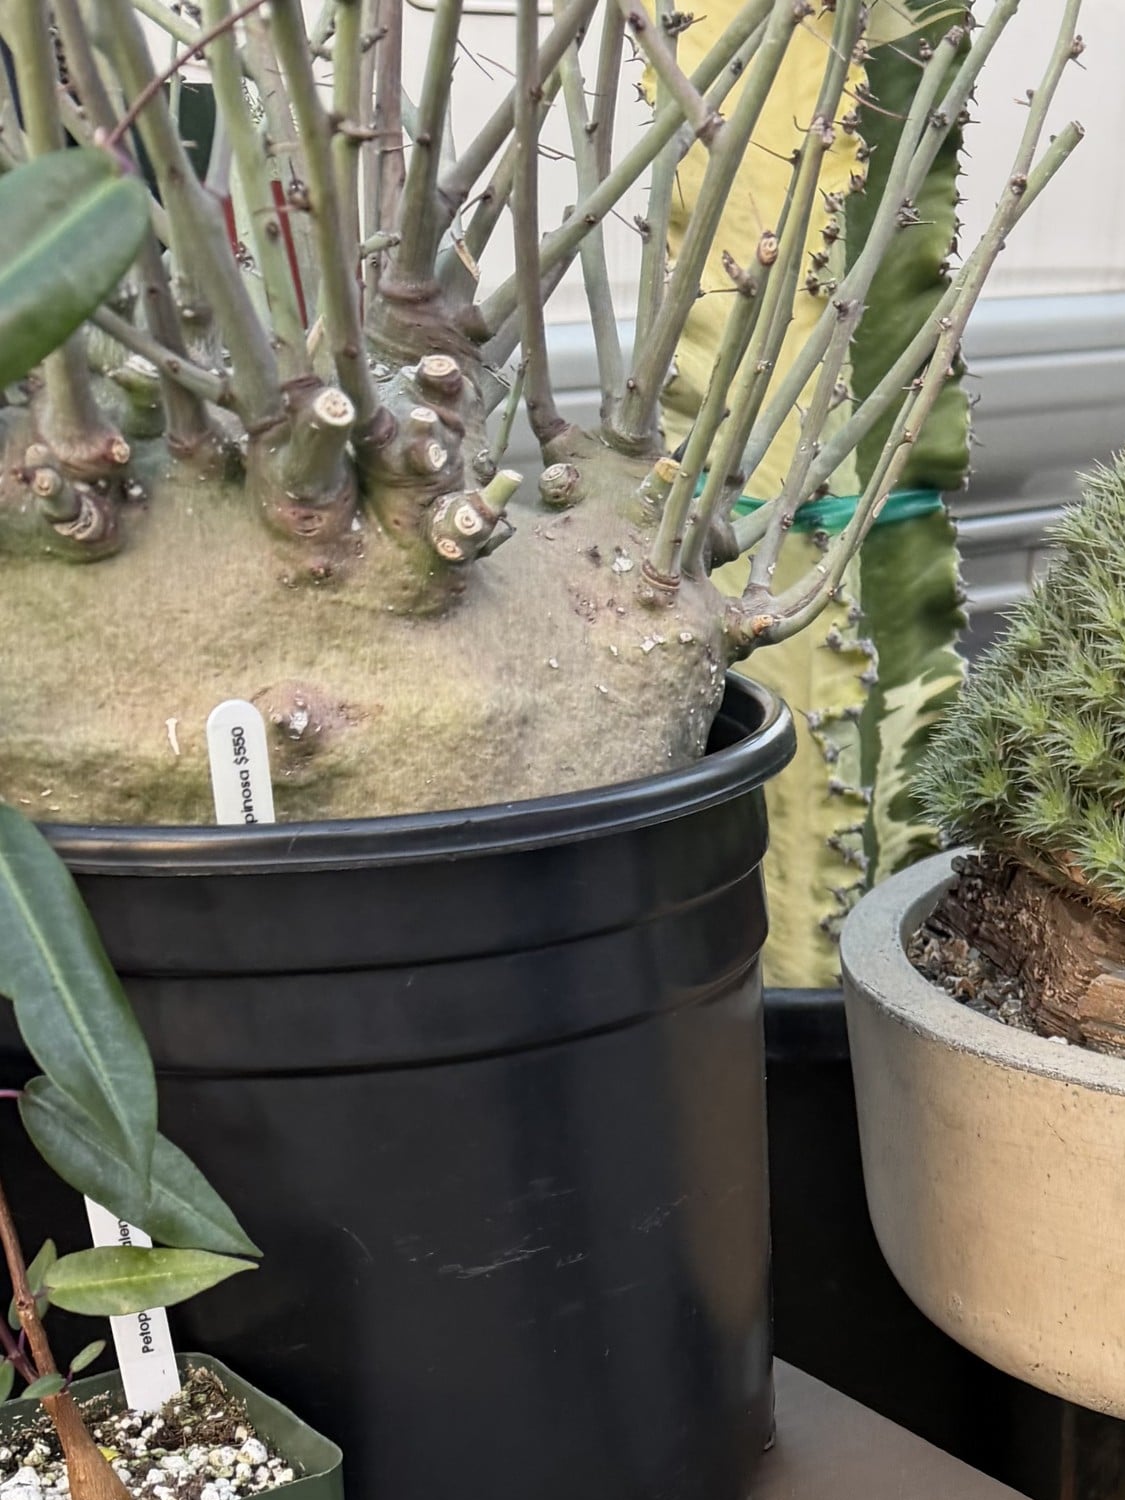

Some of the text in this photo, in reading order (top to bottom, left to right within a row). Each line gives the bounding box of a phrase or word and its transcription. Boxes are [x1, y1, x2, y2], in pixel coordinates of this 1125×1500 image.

[231, 726, 258, 825] pinosa $550
[138, 1312, 155, 1355] Petop
